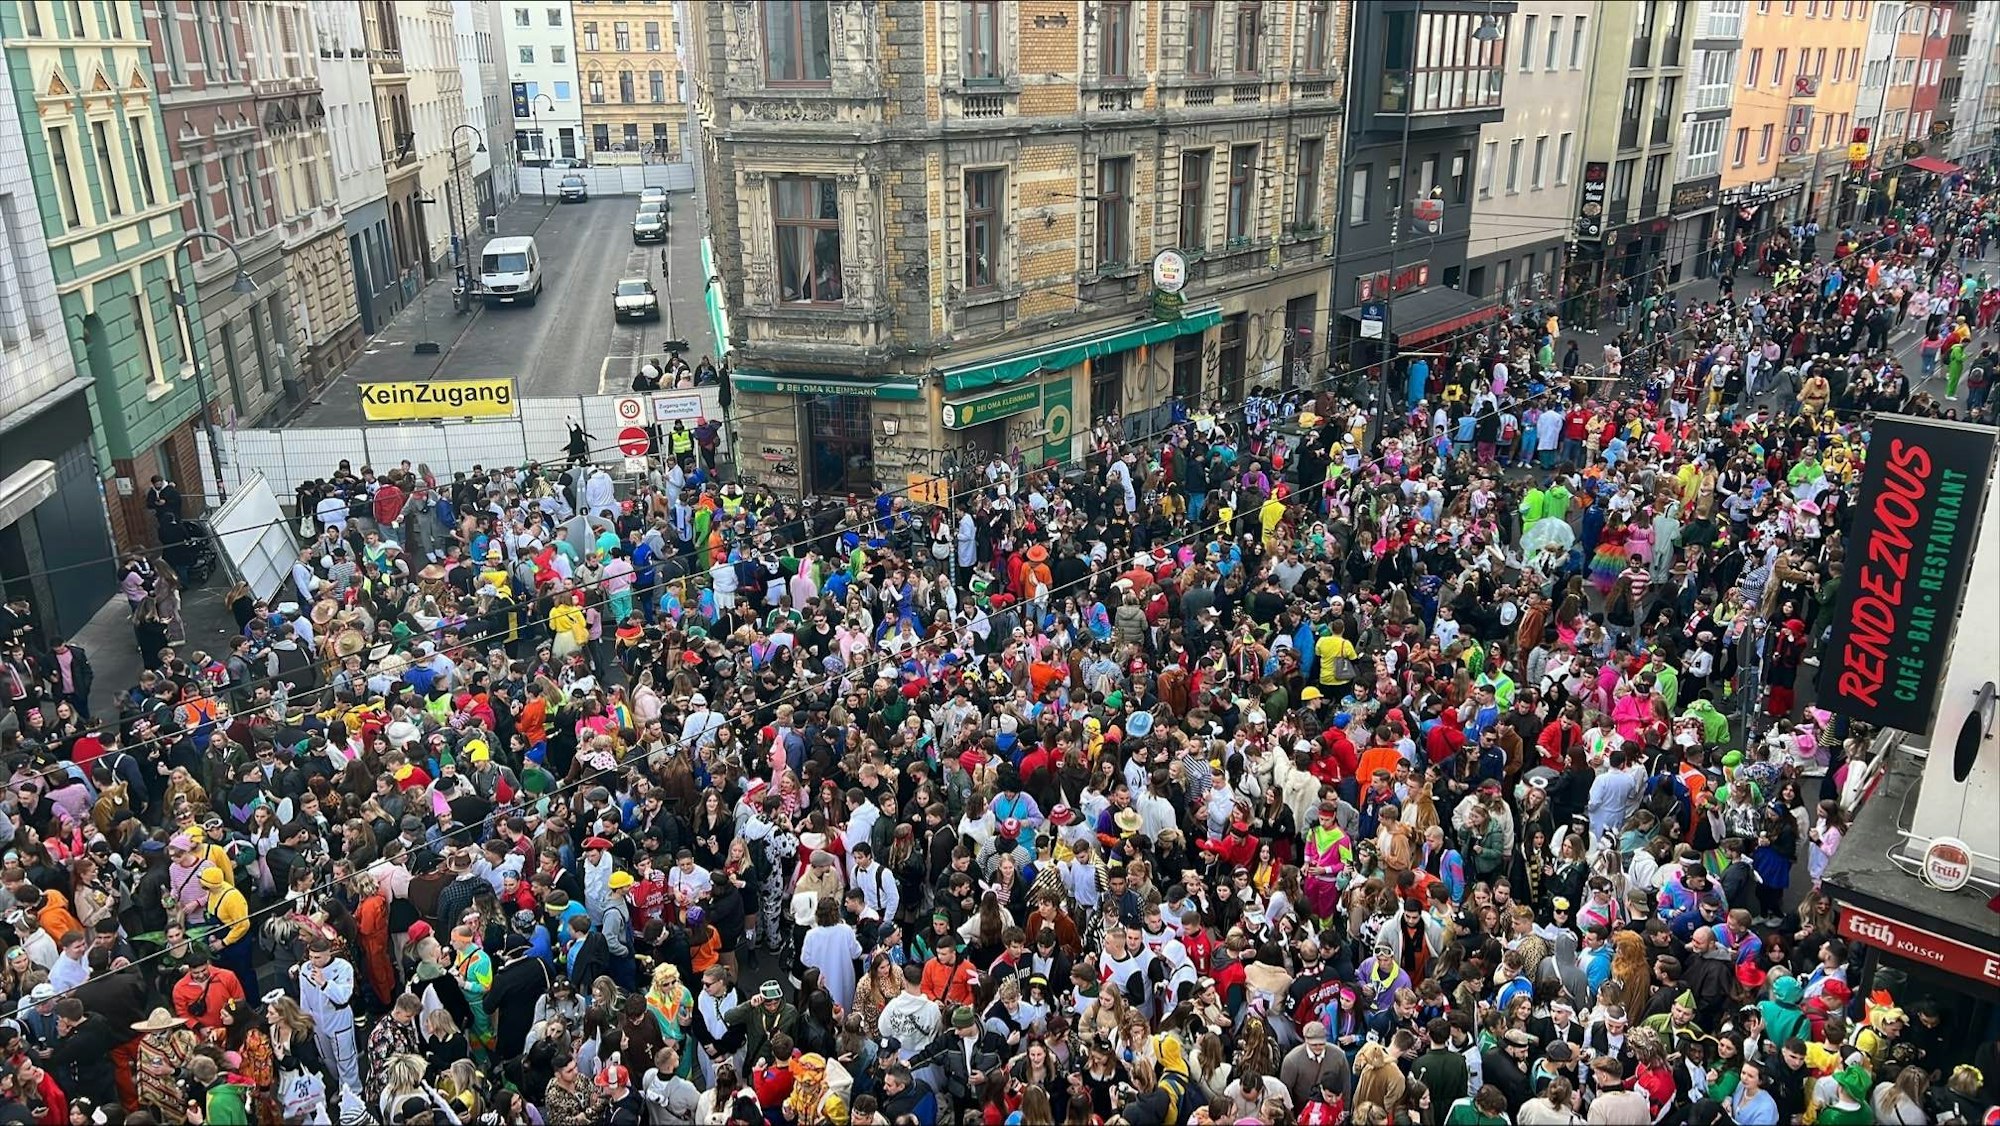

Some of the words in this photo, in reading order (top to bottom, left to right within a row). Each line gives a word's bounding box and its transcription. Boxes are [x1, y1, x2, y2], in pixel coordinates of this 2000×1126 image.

[359, 384, 510, 407] KeinZugang
[787, 384, 800, 392] BEI
[803, 384, 823, 393] OMA
[825, 385, 877, 396] KLEINMANN
[977, 404, 988, 413] BEI
[987, 401, 1002, 410] OMA
[1002, 392, 1035, 406] KLEINMANN
[624, 404, 636, 414] 30
[1919, 468, 1968, 592] RESTAURANT
[1838, 437, 1932, 708] RENDEZVOUS
[1907, 607, 1936, 643] BAR
[1893, 656, 1924, 702] CAFÉ
[1897, 937, 1945, 962] KÖLSCH
